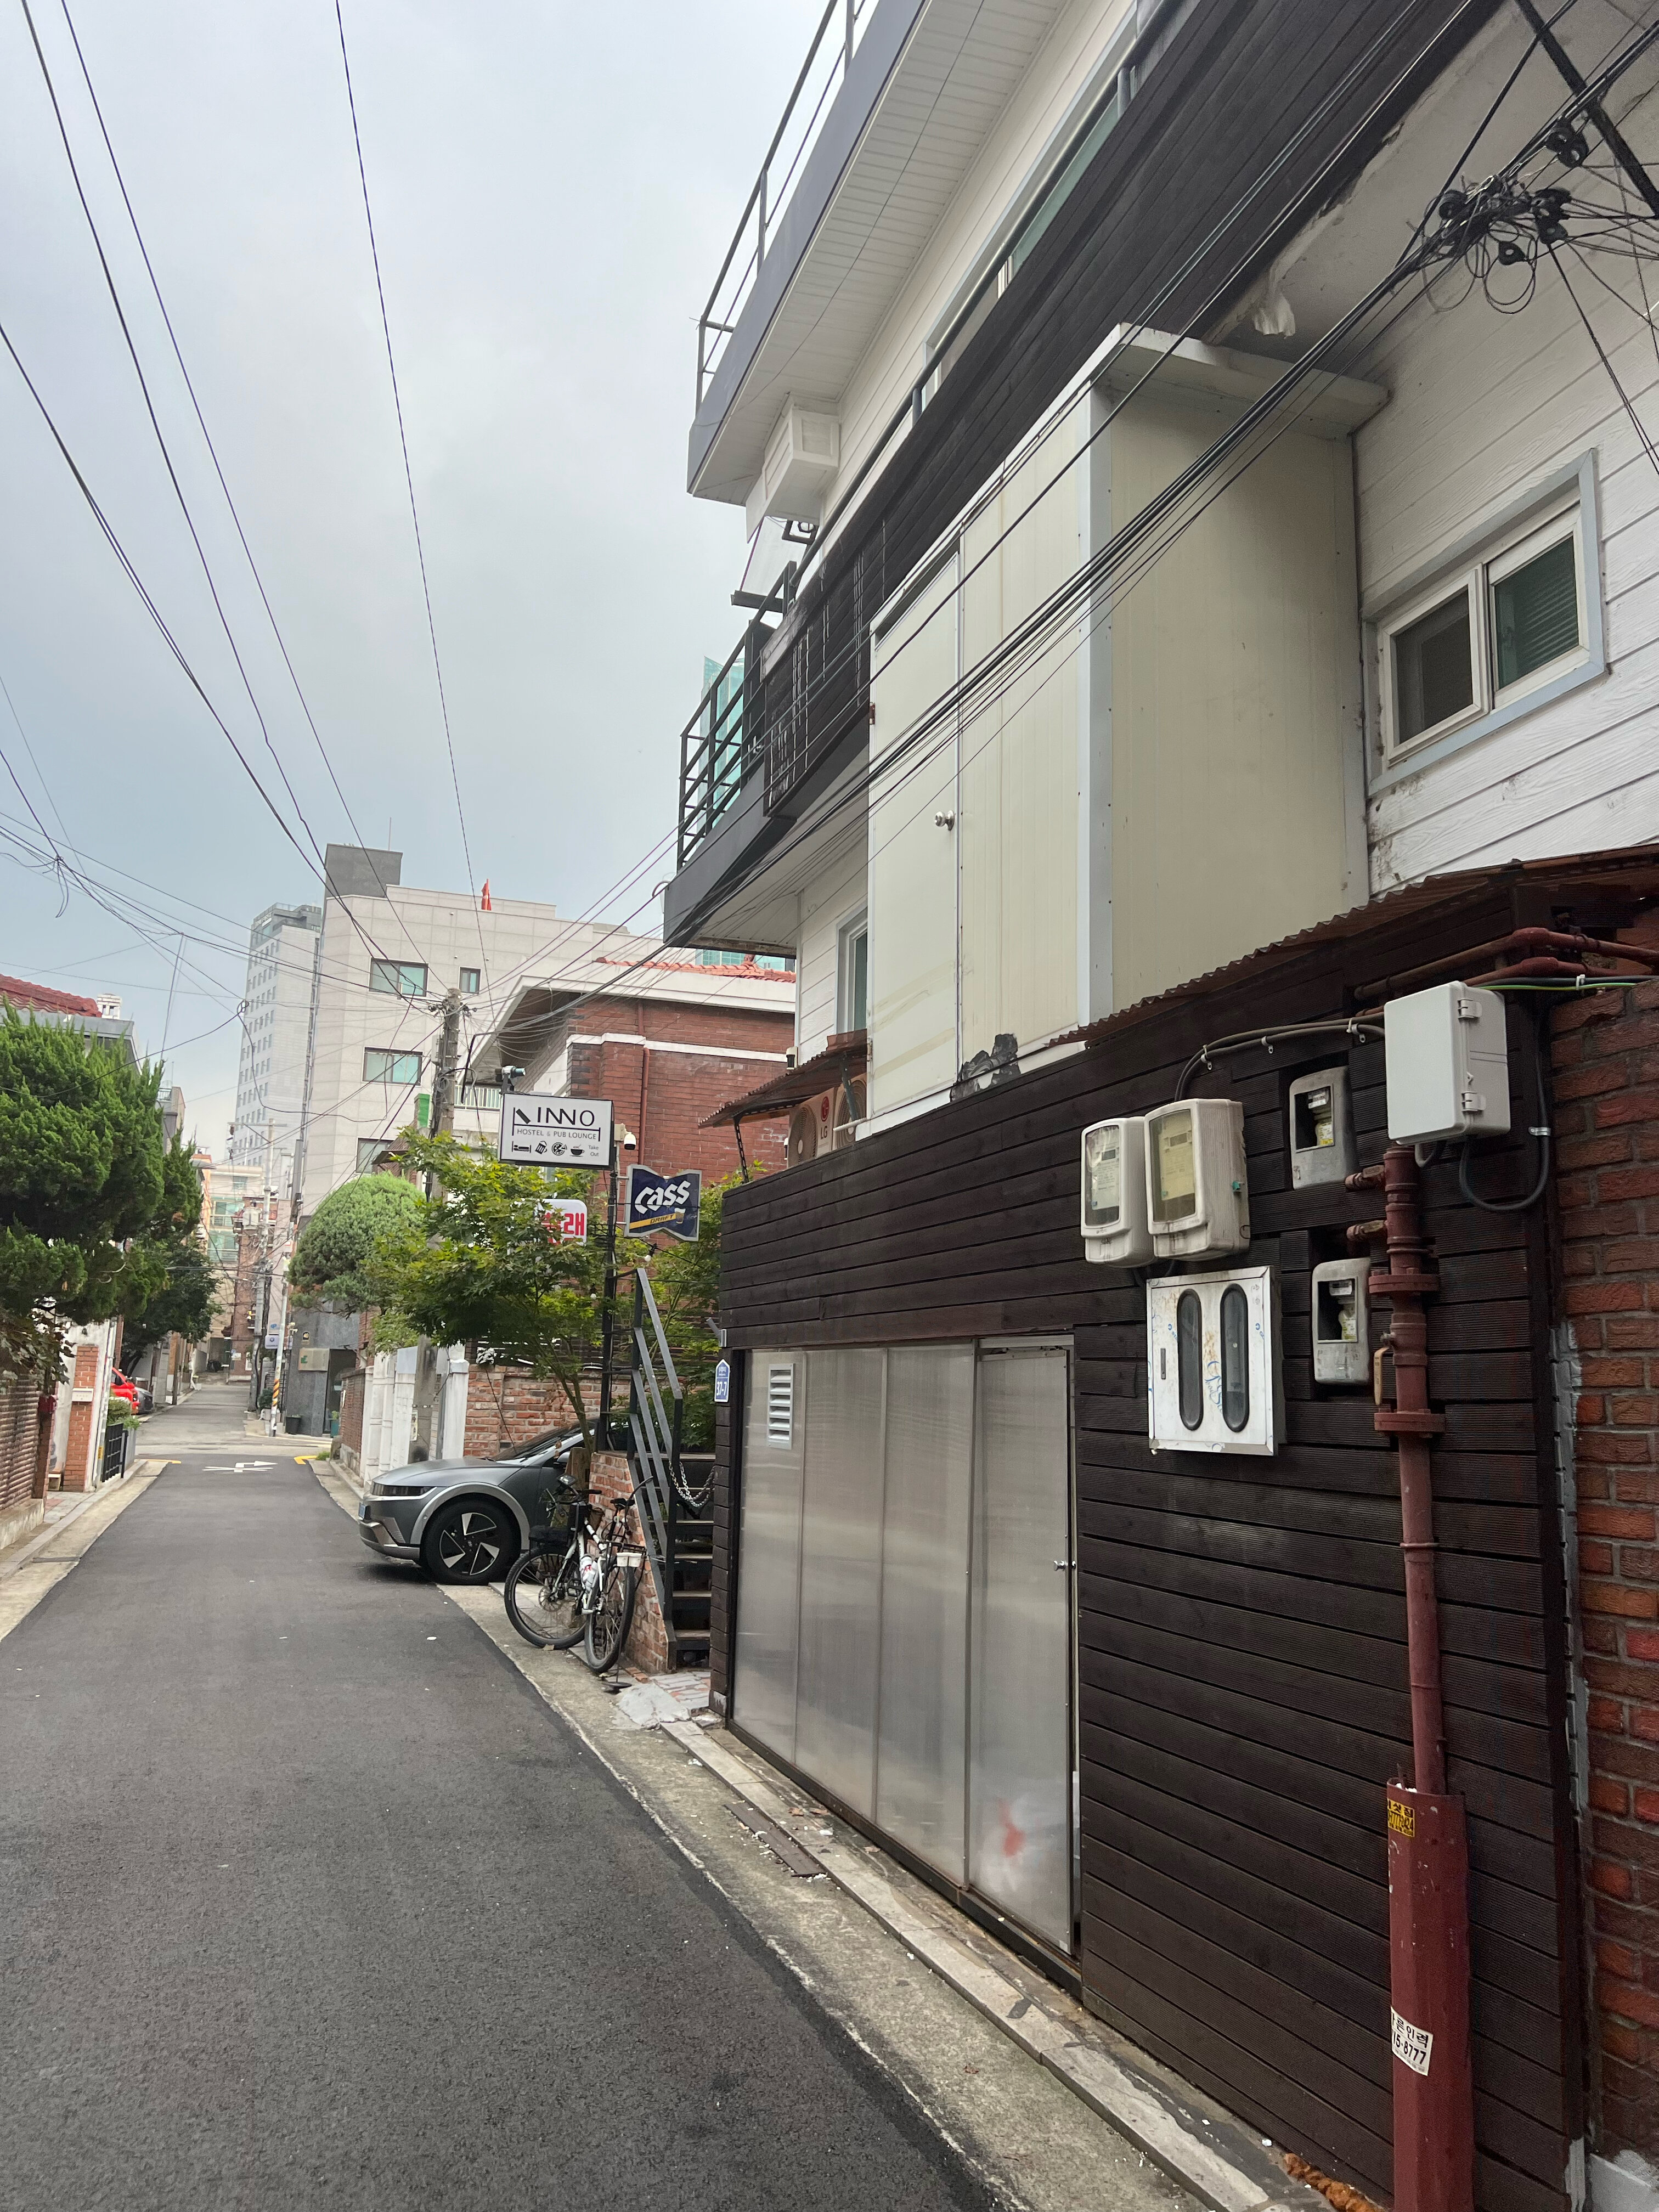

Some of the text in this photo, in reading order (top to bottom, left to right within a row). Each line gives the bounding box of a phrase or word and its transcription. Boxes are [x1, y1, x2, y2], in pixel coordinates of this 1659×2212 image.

[537, 1107, 595, 1126] INNO
[517, 1128, 544, 1136] HOSTEL
[821, 1126, 828, 1139] LG
[650, 1214, 674, 1224] DRAFT
[716, 1381, 727, 1396] 37-7
